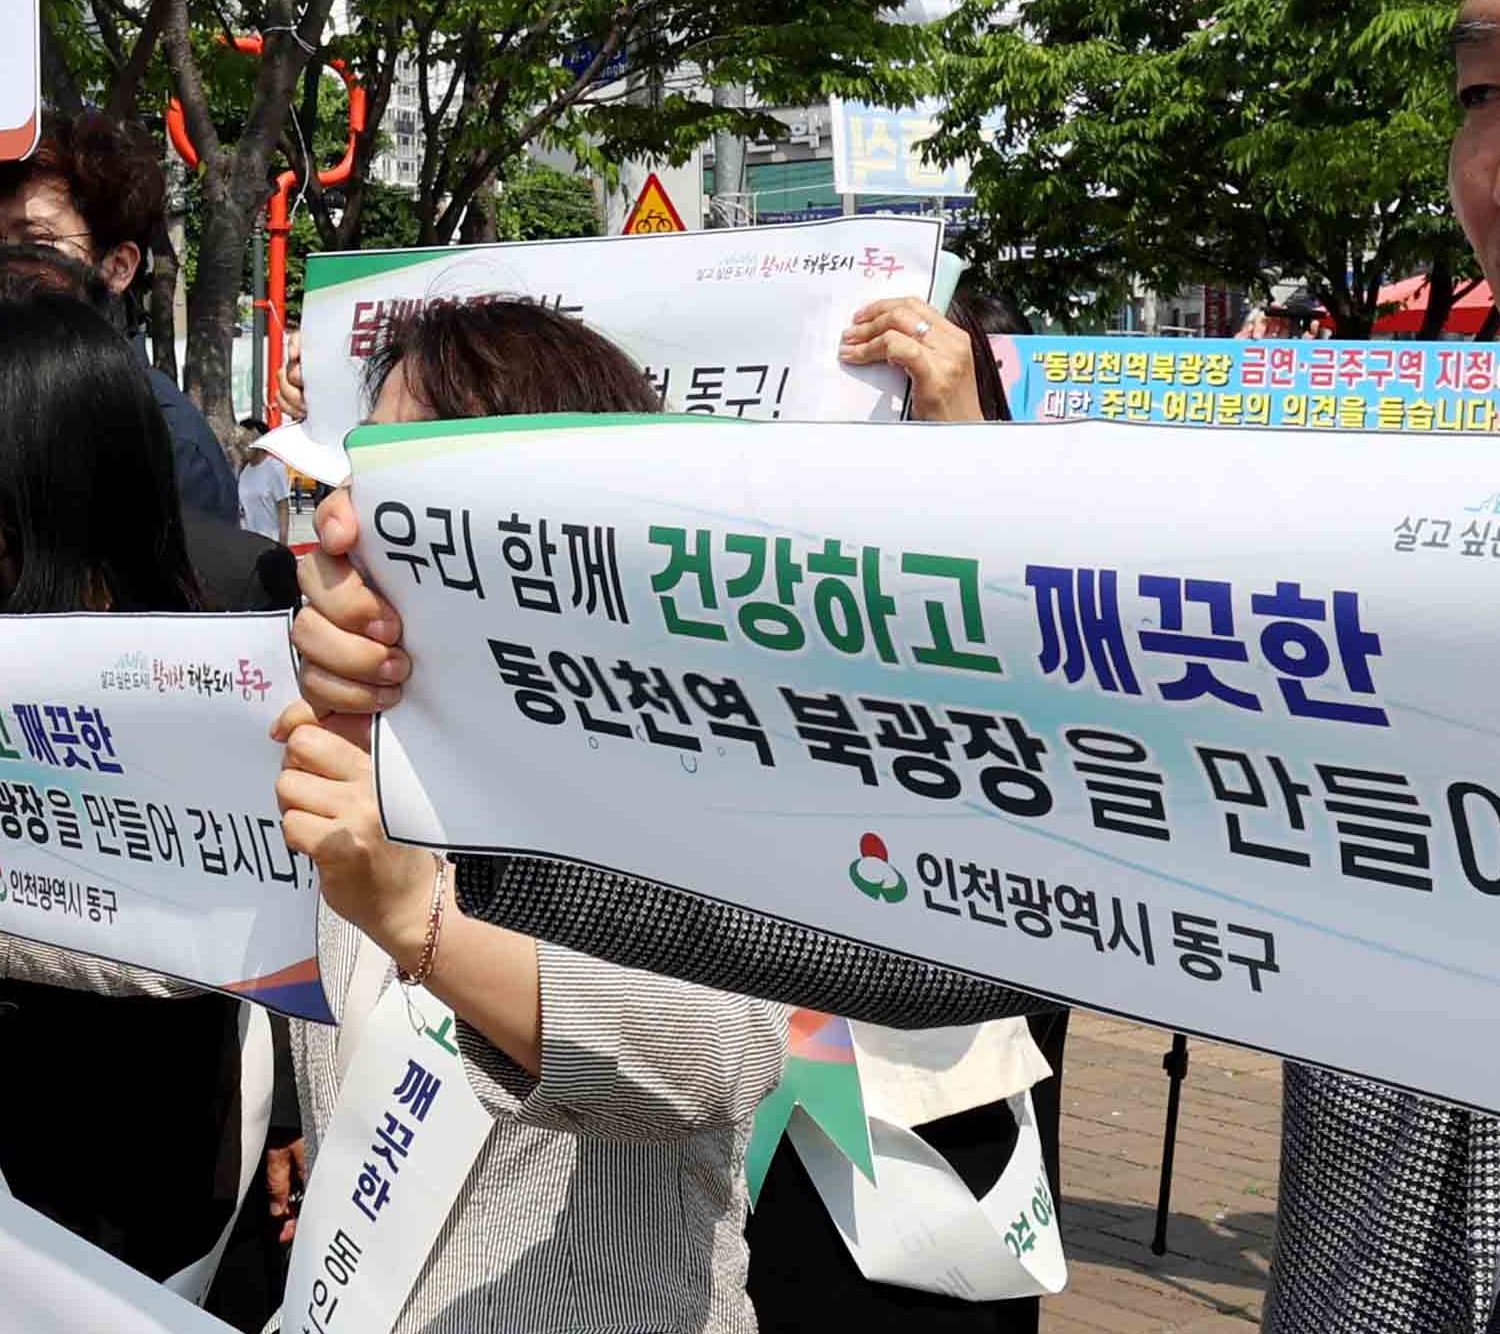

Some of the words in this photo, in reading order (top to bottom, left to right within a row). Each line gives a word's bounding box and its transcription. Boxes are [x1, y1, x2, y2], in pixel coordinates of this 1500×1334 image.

[856, 247, 906, 280] 동구
[1239, 346, 1427, 390] 금연·금주구역
[1043, 392, 1094, 420] 대한
[1099, 391, 1153, 423] 주민
[1161, 392, 1272, 426] 여러분의
[1280, 395, 1369, 428] 의견을
[1392, 513, 1451, 555] 살고
[372, 498, 486, 602] 우리
[495, 512, 632, 627] 함께
[645, 523, 1006, 677] 건강하고
[1022, 560, 1391, 729] 깨끗한
[187, 662, 234, 698] 행복도시
[235, 658, 273, 701] 동구
[22, 703, 124, 774] 깨끗한
[485, 635, 777, 769] 동인천역
[778, 683, 1174, 845] 북광장을
[85, 795, 187, 870] 만들어
[9, 869, 84, 918] 인천광역시
[85, 888, 119, 926] 동구
[913, 851, 1158, 967] 인천광역시
[1168, 916, 1283, 996] 동구
[351, 1058, 443, 1223] 깨끗한
